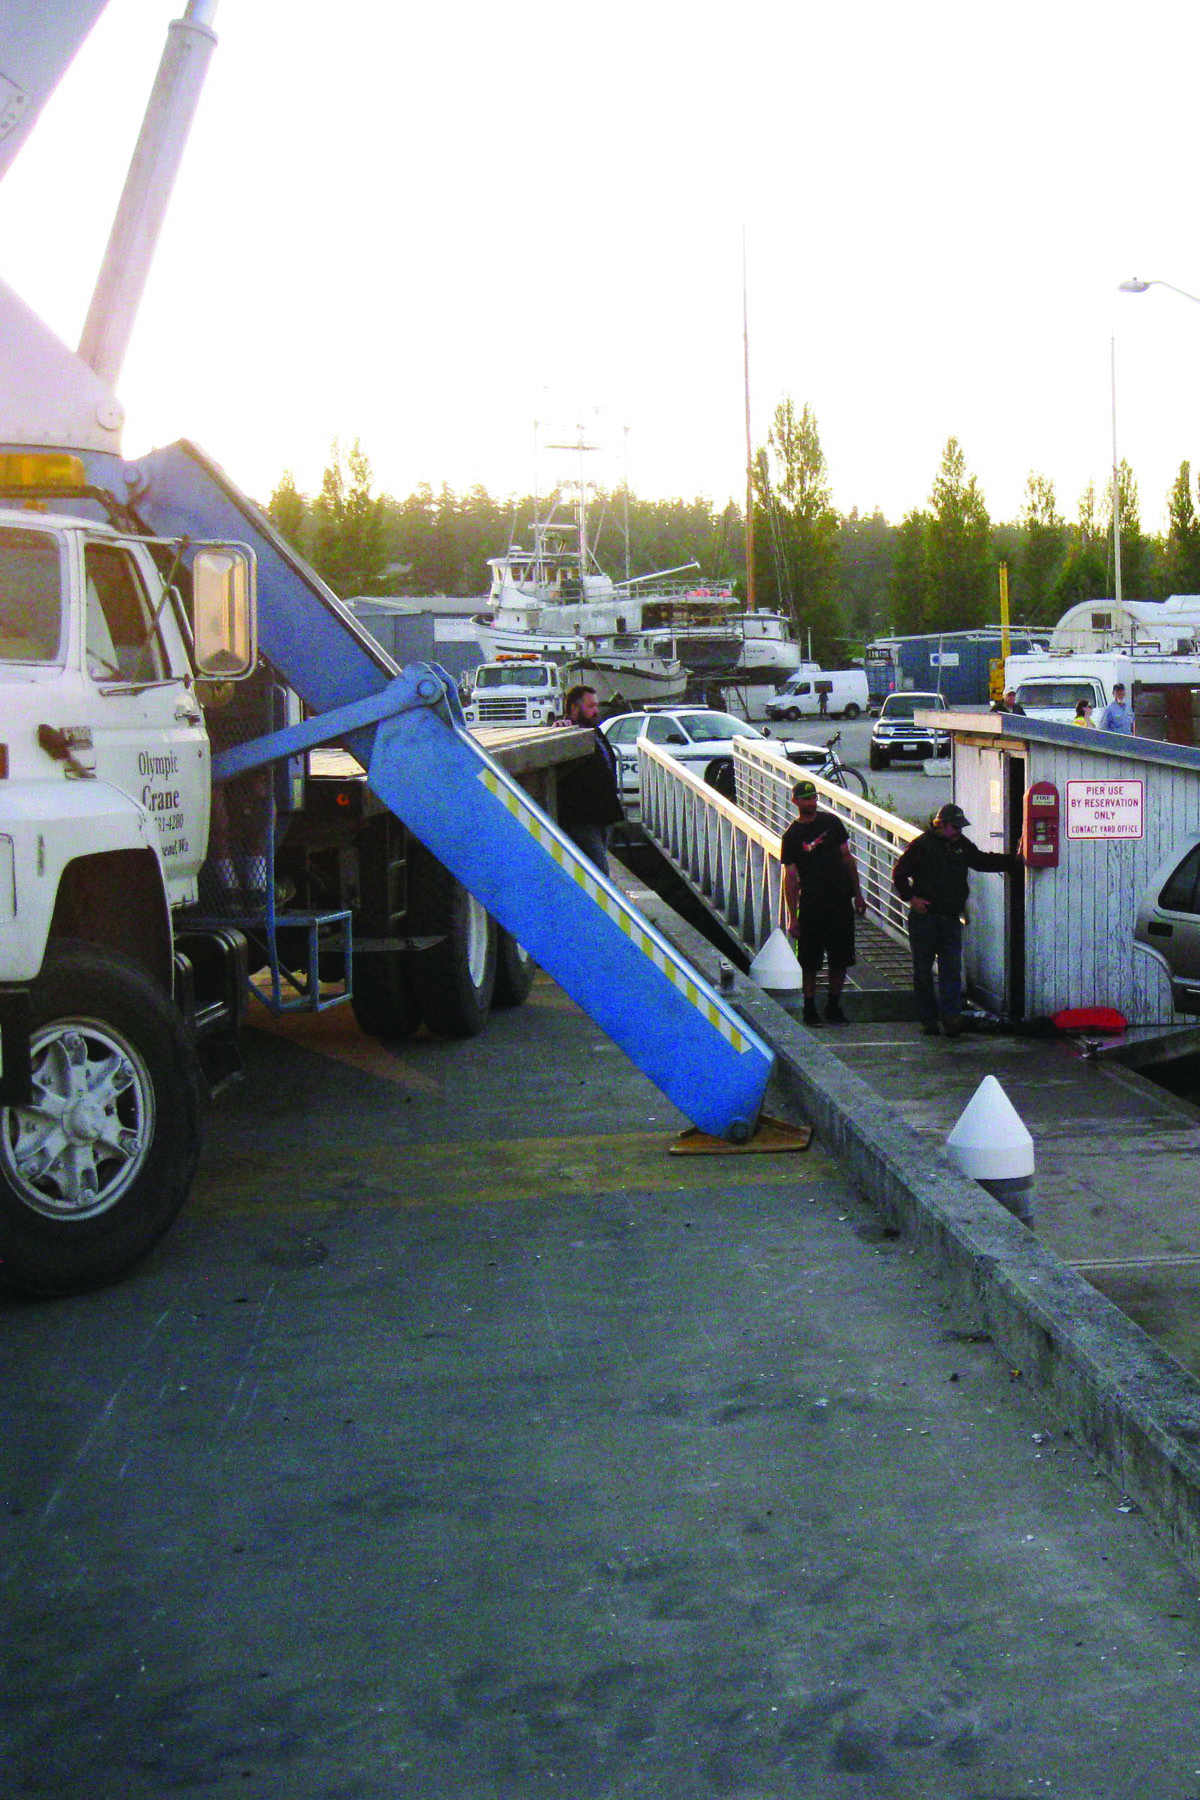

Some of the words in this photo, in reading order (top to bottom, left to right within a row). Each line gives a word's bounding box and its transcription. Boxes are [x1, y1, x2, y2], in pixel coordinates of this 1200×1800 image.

[138, 750, 179, 782] Olympic
[1086, 786, 1106, 796] PIER
[1108, 786, 1124, 796] USE
[142, 785, 180, 812] Crane
[1071, 798, 1082, 808] BY
[1084, 798, 1139, 808] RESERVATION
[1094, 811, 1116, 820] ONLY
[1072, 825, 1098, 834] CONTACT
[1099, 825, 1115, 834] YARD
[1117, 825, 1138, 834] OFFICE
